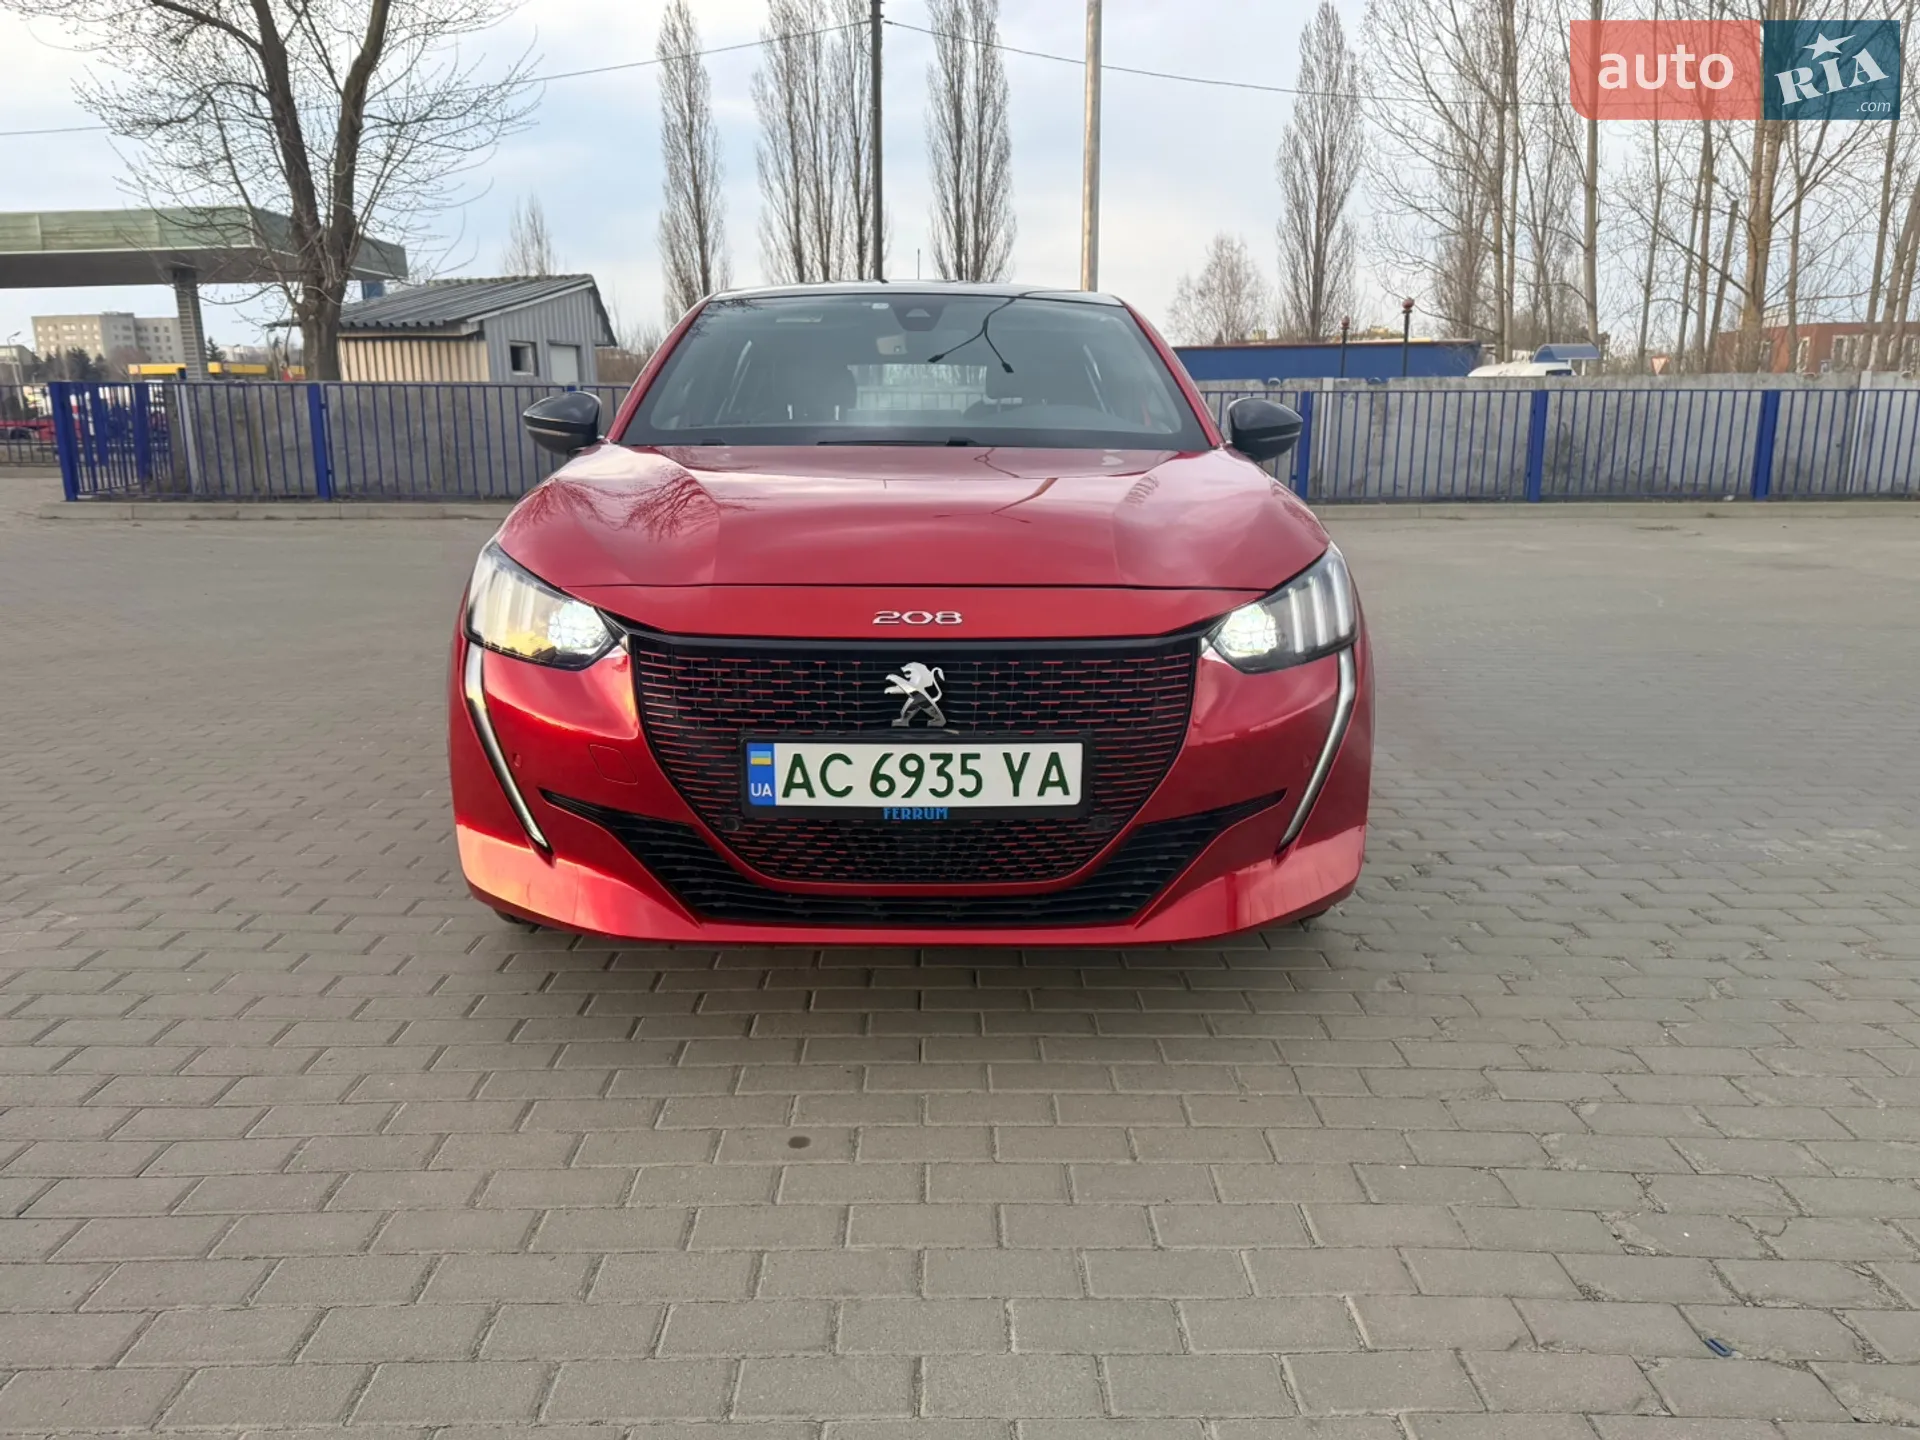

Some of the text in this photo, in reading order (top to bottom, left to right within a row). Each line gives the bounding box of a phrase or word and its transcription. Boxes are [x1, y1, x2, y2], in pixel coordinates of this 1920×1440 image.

[872, 610, 963, 625] 208
[781, 752, 1070, 798] AC 6935 YA
[750, 782, 772, 798] UA
[883, 807, 949, 820] FERRUM
